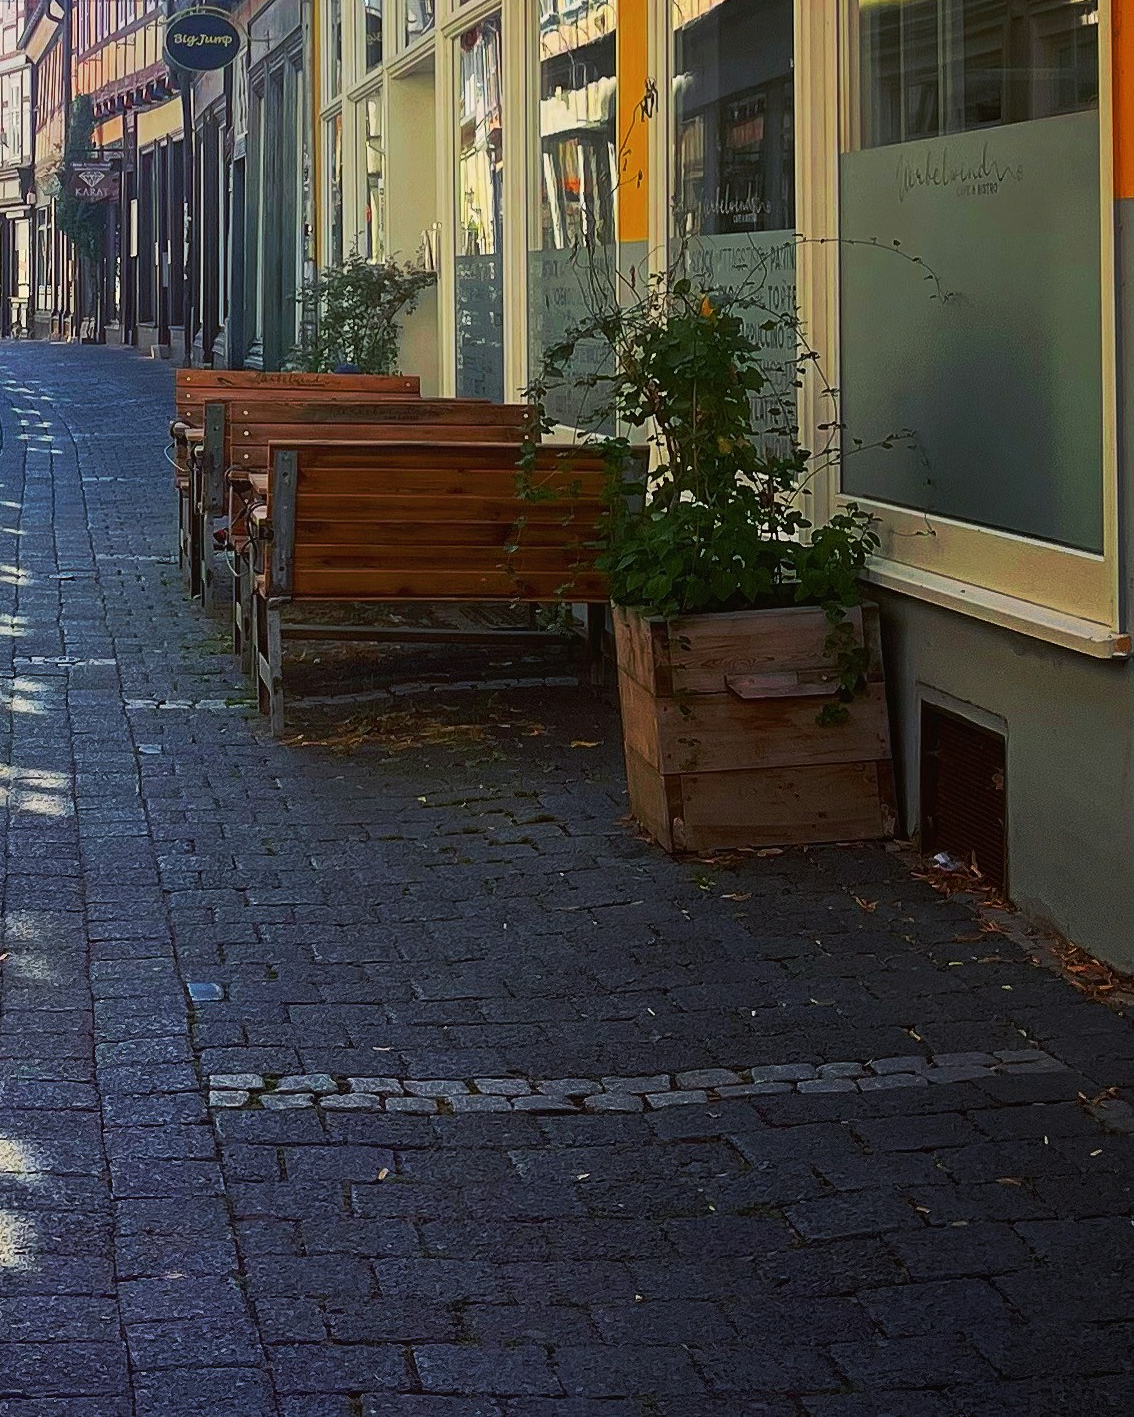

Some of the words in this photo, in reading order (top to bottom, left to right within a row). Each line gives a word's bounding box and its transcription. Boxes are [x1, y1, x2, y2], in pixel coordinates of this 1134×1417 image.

[173, 33, 198, 47] Big
[195, 33, 233, 48] Jump
[75, 187, 109, 197] KARAT
